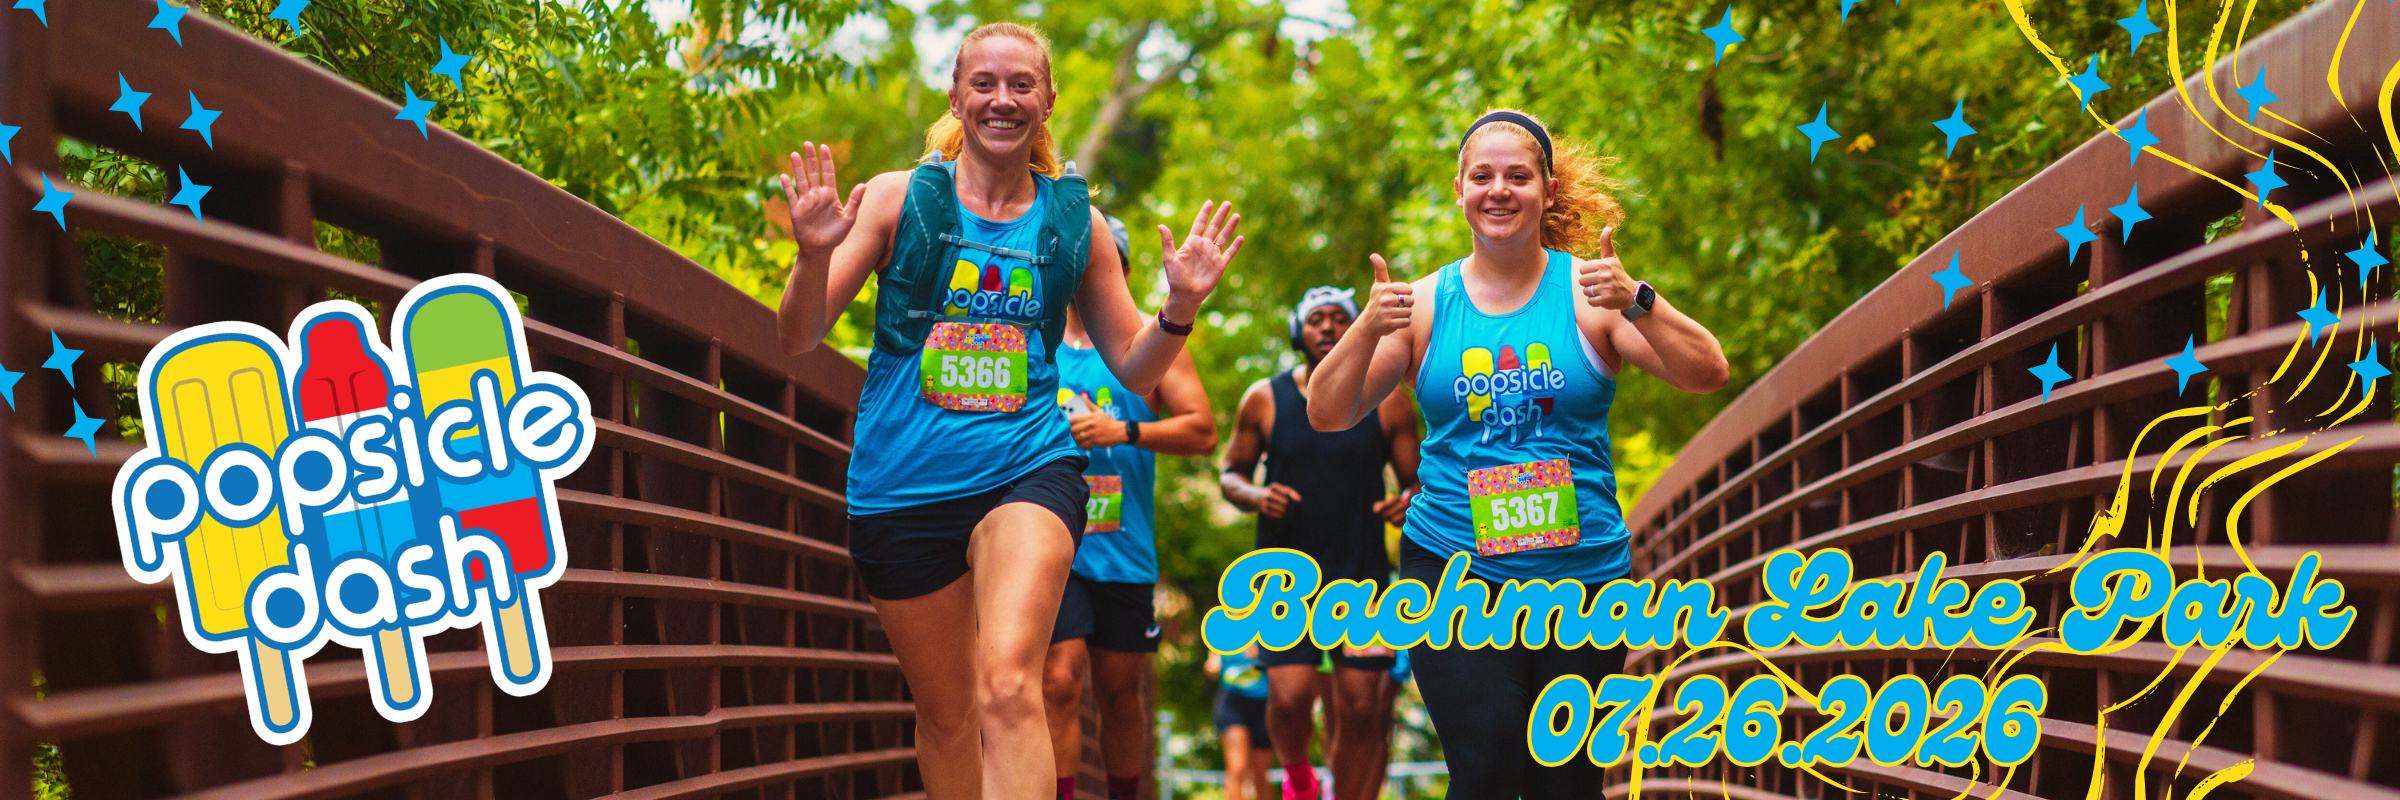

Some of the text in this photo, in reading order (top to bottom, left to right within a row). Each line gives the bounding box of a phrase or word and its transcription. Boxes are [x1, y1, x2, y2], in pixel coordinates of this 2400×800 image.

[941, 354, 1011, 389] 5366
[1453, 362, 1566, 404] popsicle
[1481, 397, 1543, 427] dash
[1490, 491, 1559, 531] 5367
